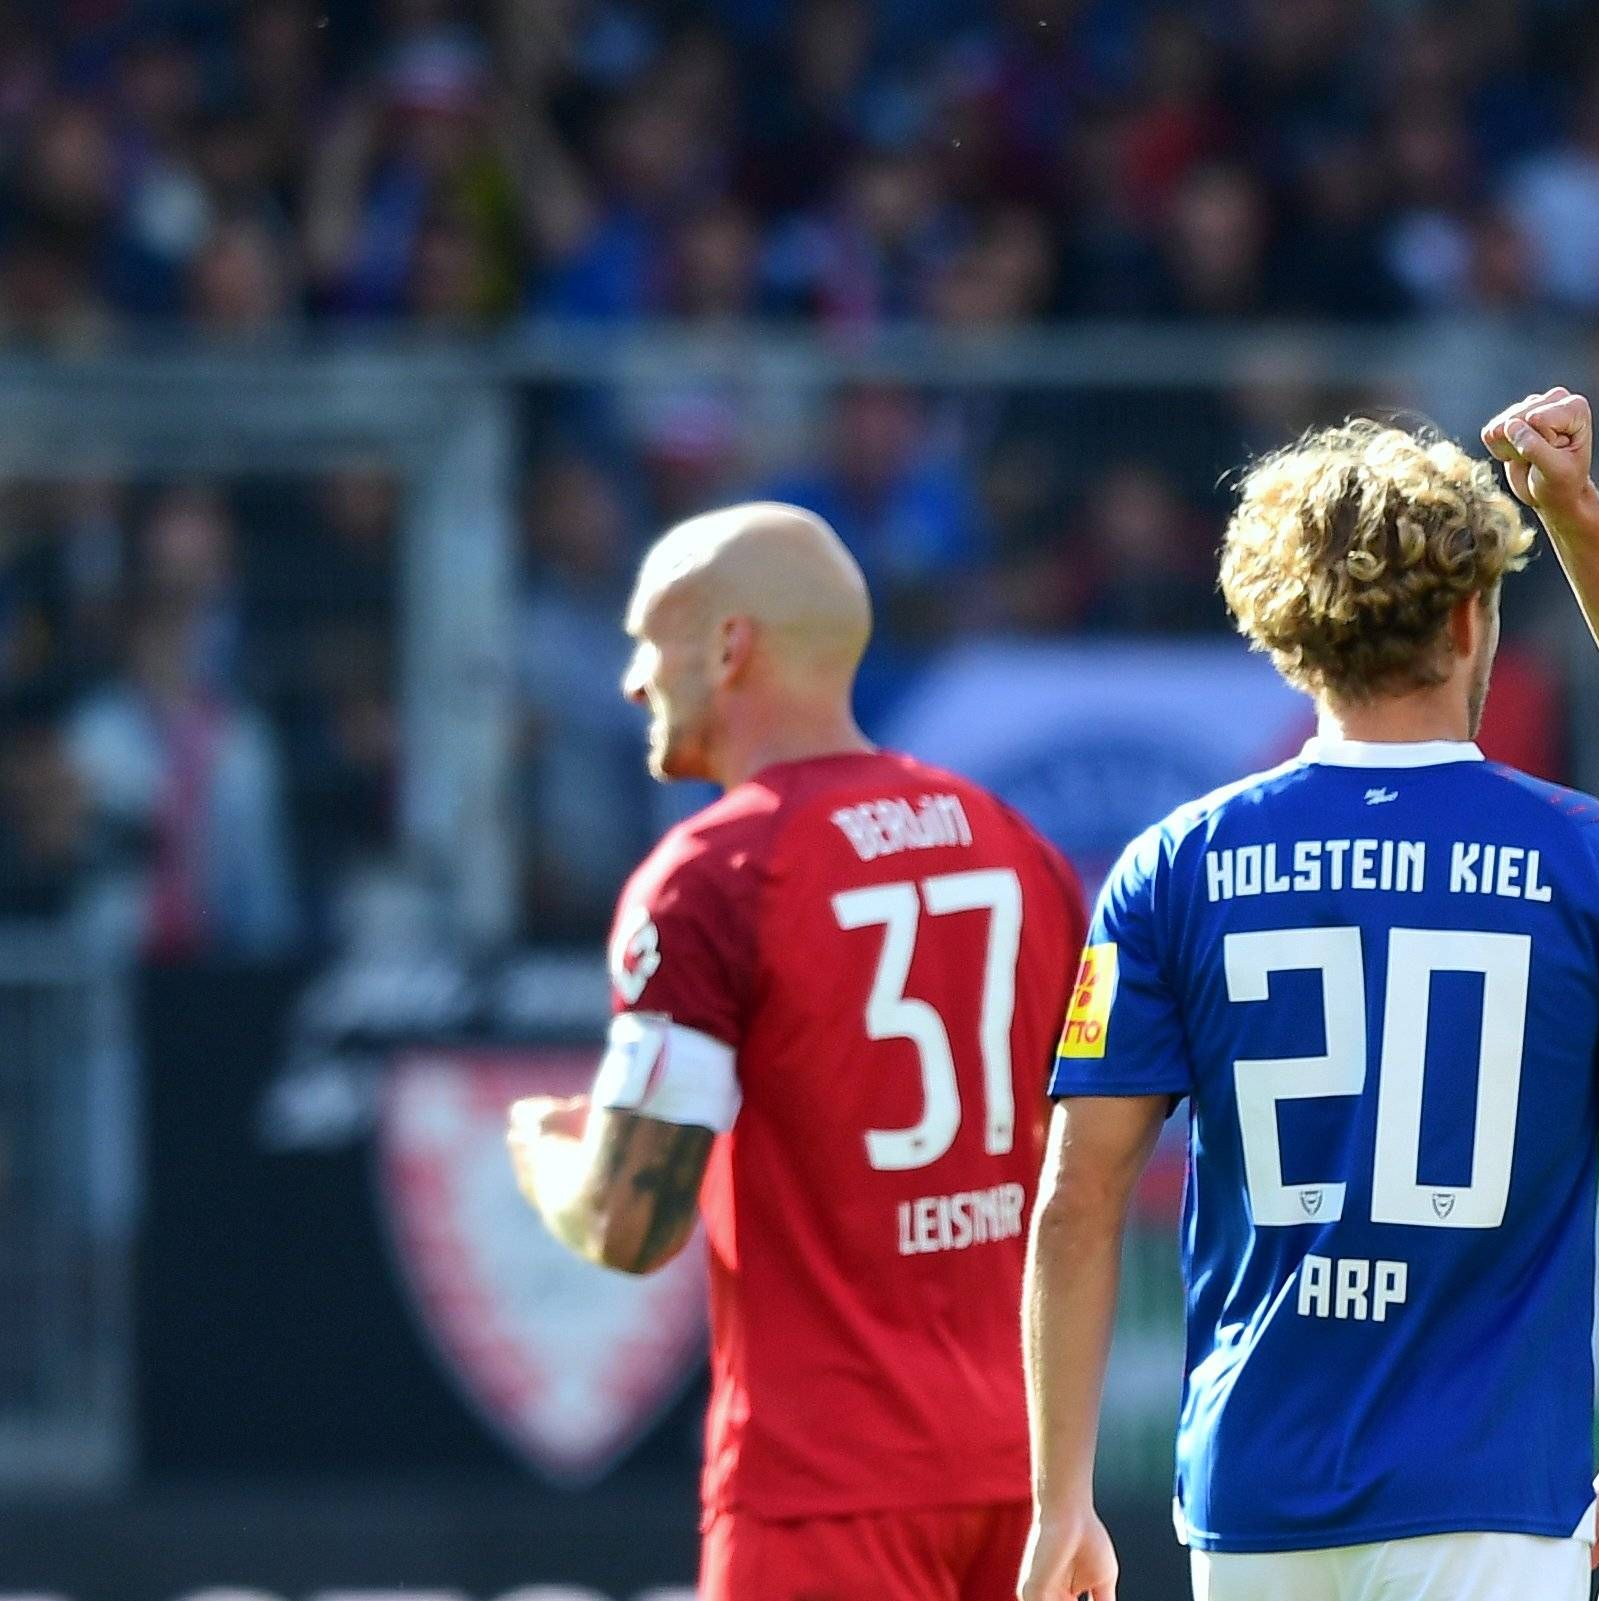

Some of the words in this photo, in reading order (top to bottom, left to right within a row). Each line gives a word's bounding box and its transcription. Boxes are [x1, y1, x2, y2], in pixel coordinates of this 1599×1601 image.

[1206, 839, 1426, 902] HOLSTEIN
[1449, 842, 1553, 903] KIEL
[831, 867, 1025, 1171] 37
[1223, 925, 1533, 1229] 20
[1297, 1253, 1408, 1322] ARP
